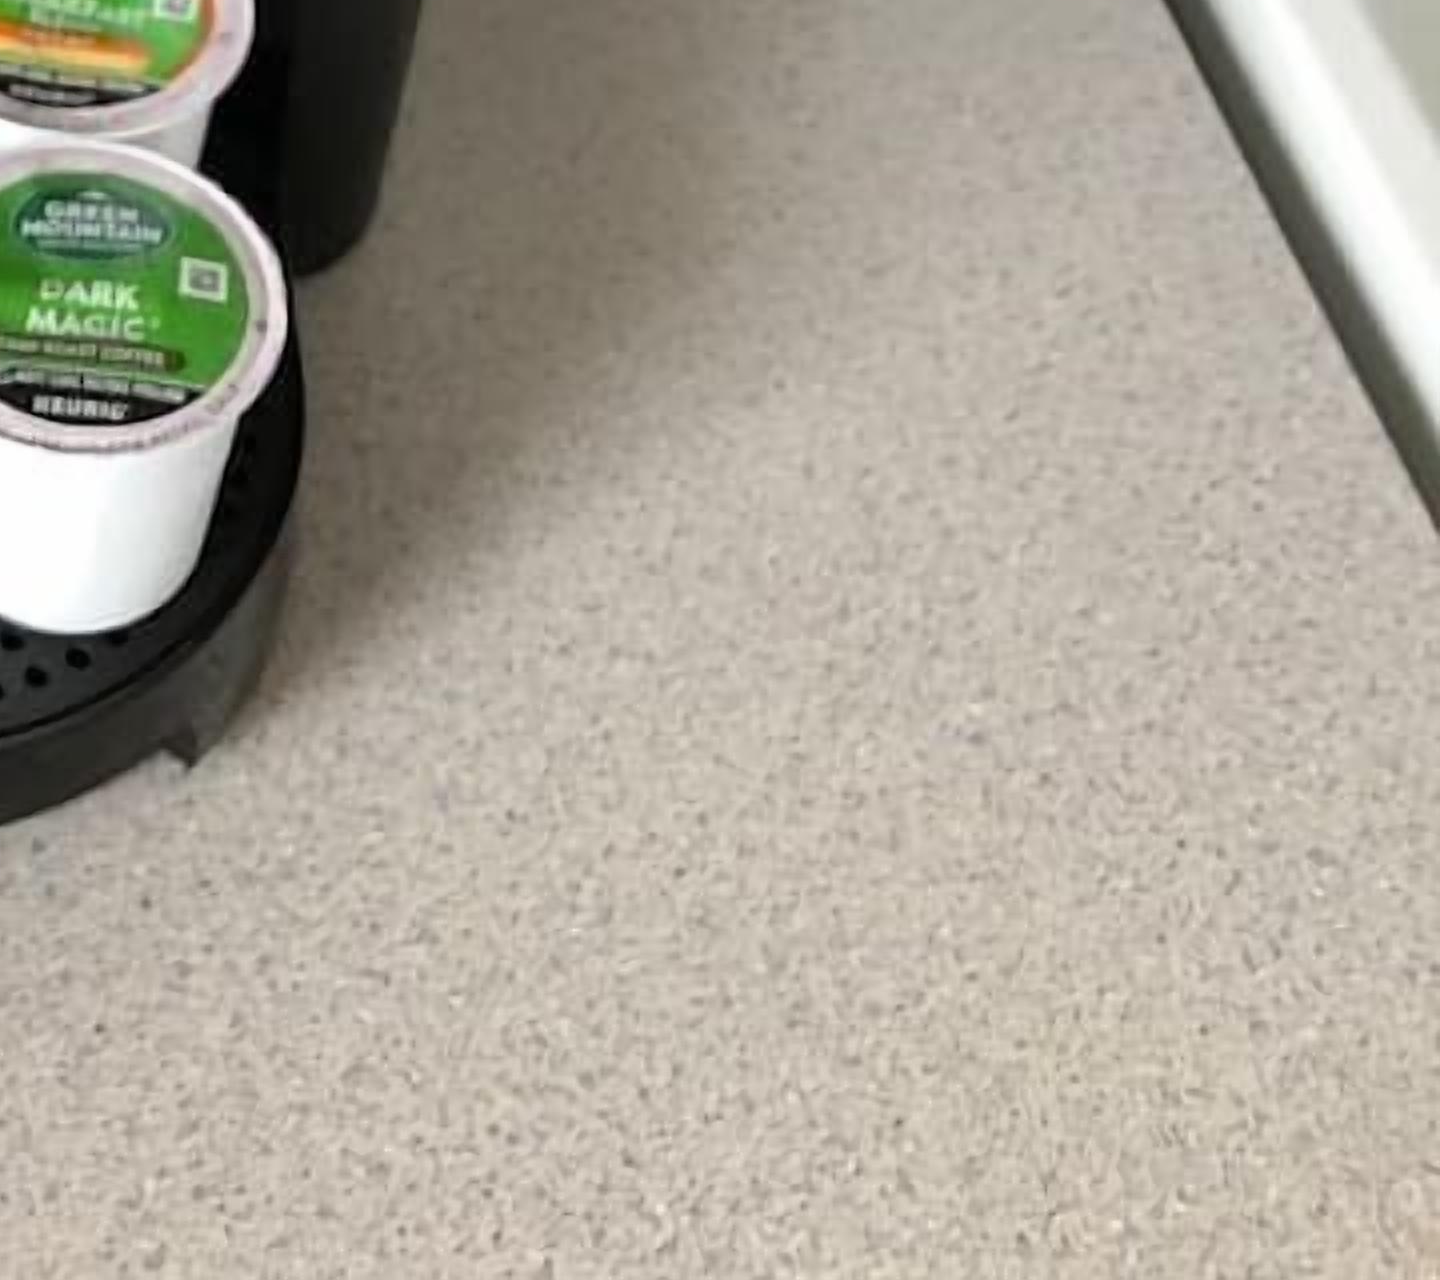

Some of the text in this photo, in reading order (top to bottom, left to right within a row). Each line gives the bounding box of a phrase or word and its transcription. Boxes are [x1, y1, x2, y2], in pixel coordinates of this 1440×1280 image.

[43, 199, 139, 223] GREEN
[21, 219, 164, 245] MOUNTAIN
[39, 277, 140, 312] DARK
[24, 306, 148, 342] MAGIC
[31, 394, 131, 421] KEURIG
